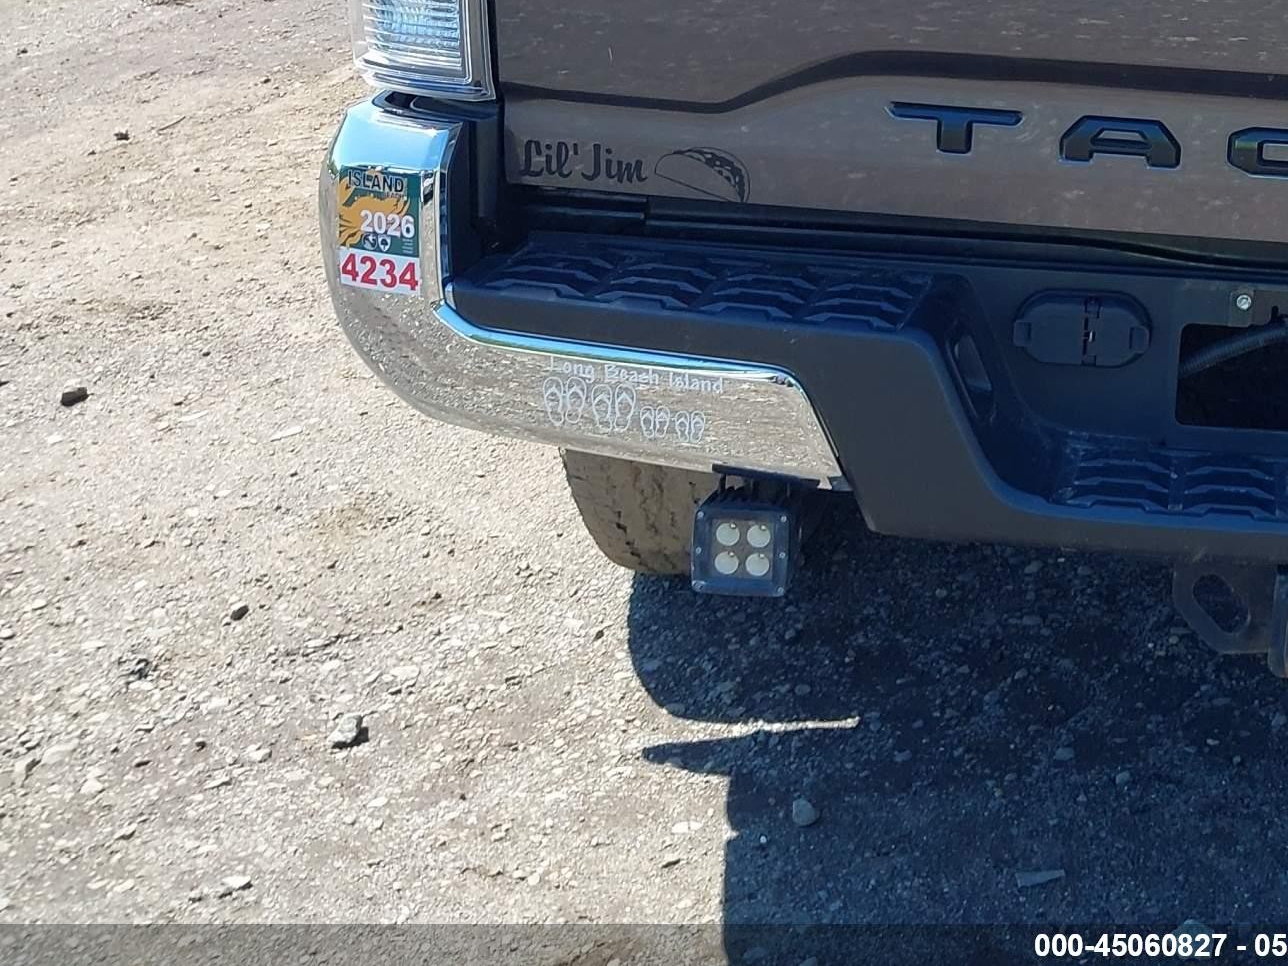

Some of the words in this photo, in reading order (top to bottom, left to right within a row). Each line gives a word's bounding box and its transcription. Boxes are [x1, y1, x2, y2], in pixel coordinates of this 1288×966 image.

[521, 140, 579, 177] Lil'
[581, 143, 648, 183] Jim
[347, 169, 405, 193] ISLAND
[360, 209, 415, 238] 2026
[341, 252, 419, 291] 4234
[549, 356, 595, 383] Long
[670, 371, 724, 394] Island
